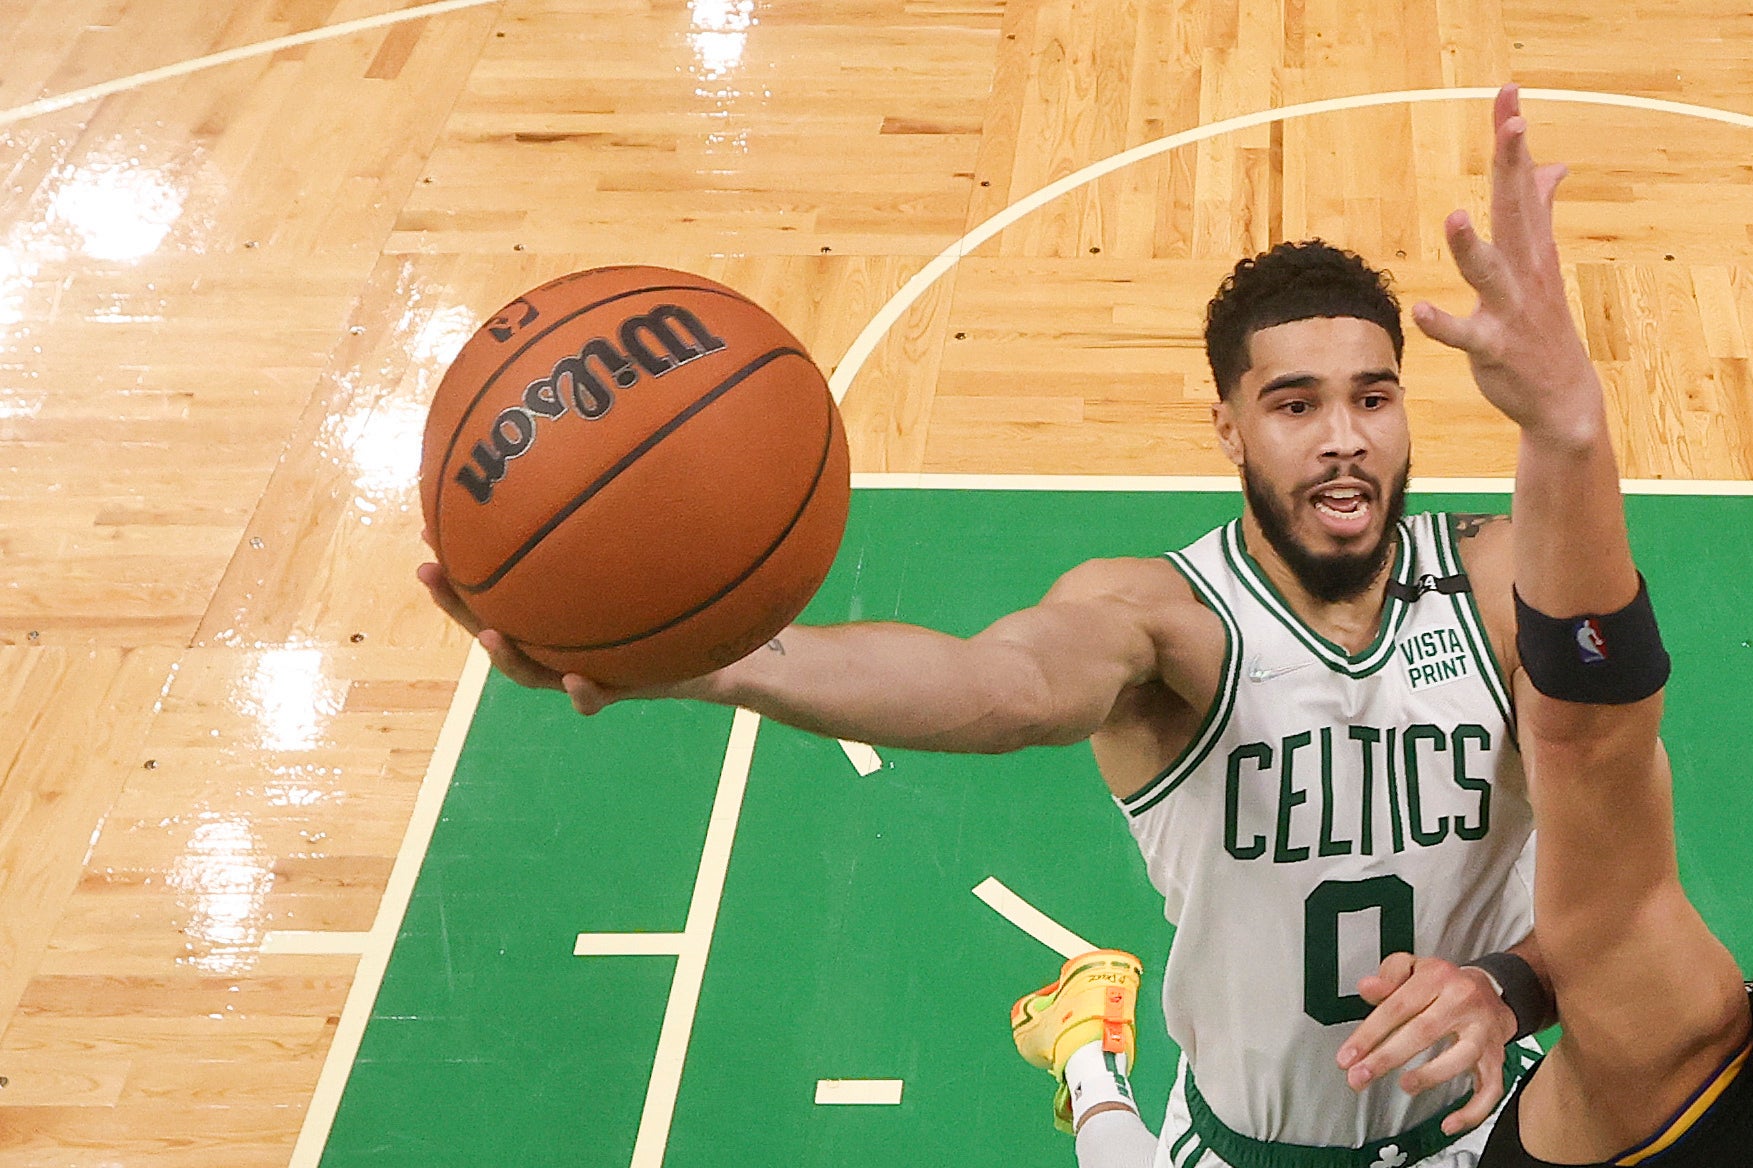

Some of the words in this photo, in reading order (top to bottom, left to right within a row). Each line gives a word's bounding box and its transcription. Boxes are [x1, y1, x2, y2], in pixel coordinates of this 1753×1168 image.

[455, 304, 726, 504] Wilson
[1401, 628, 1464, 665] VISTA
[1408, 655, 1467, 688] PRINT
[1224, 724, 1491, 863] CELTICS
[1304, 874, 1414, 1026] 0
